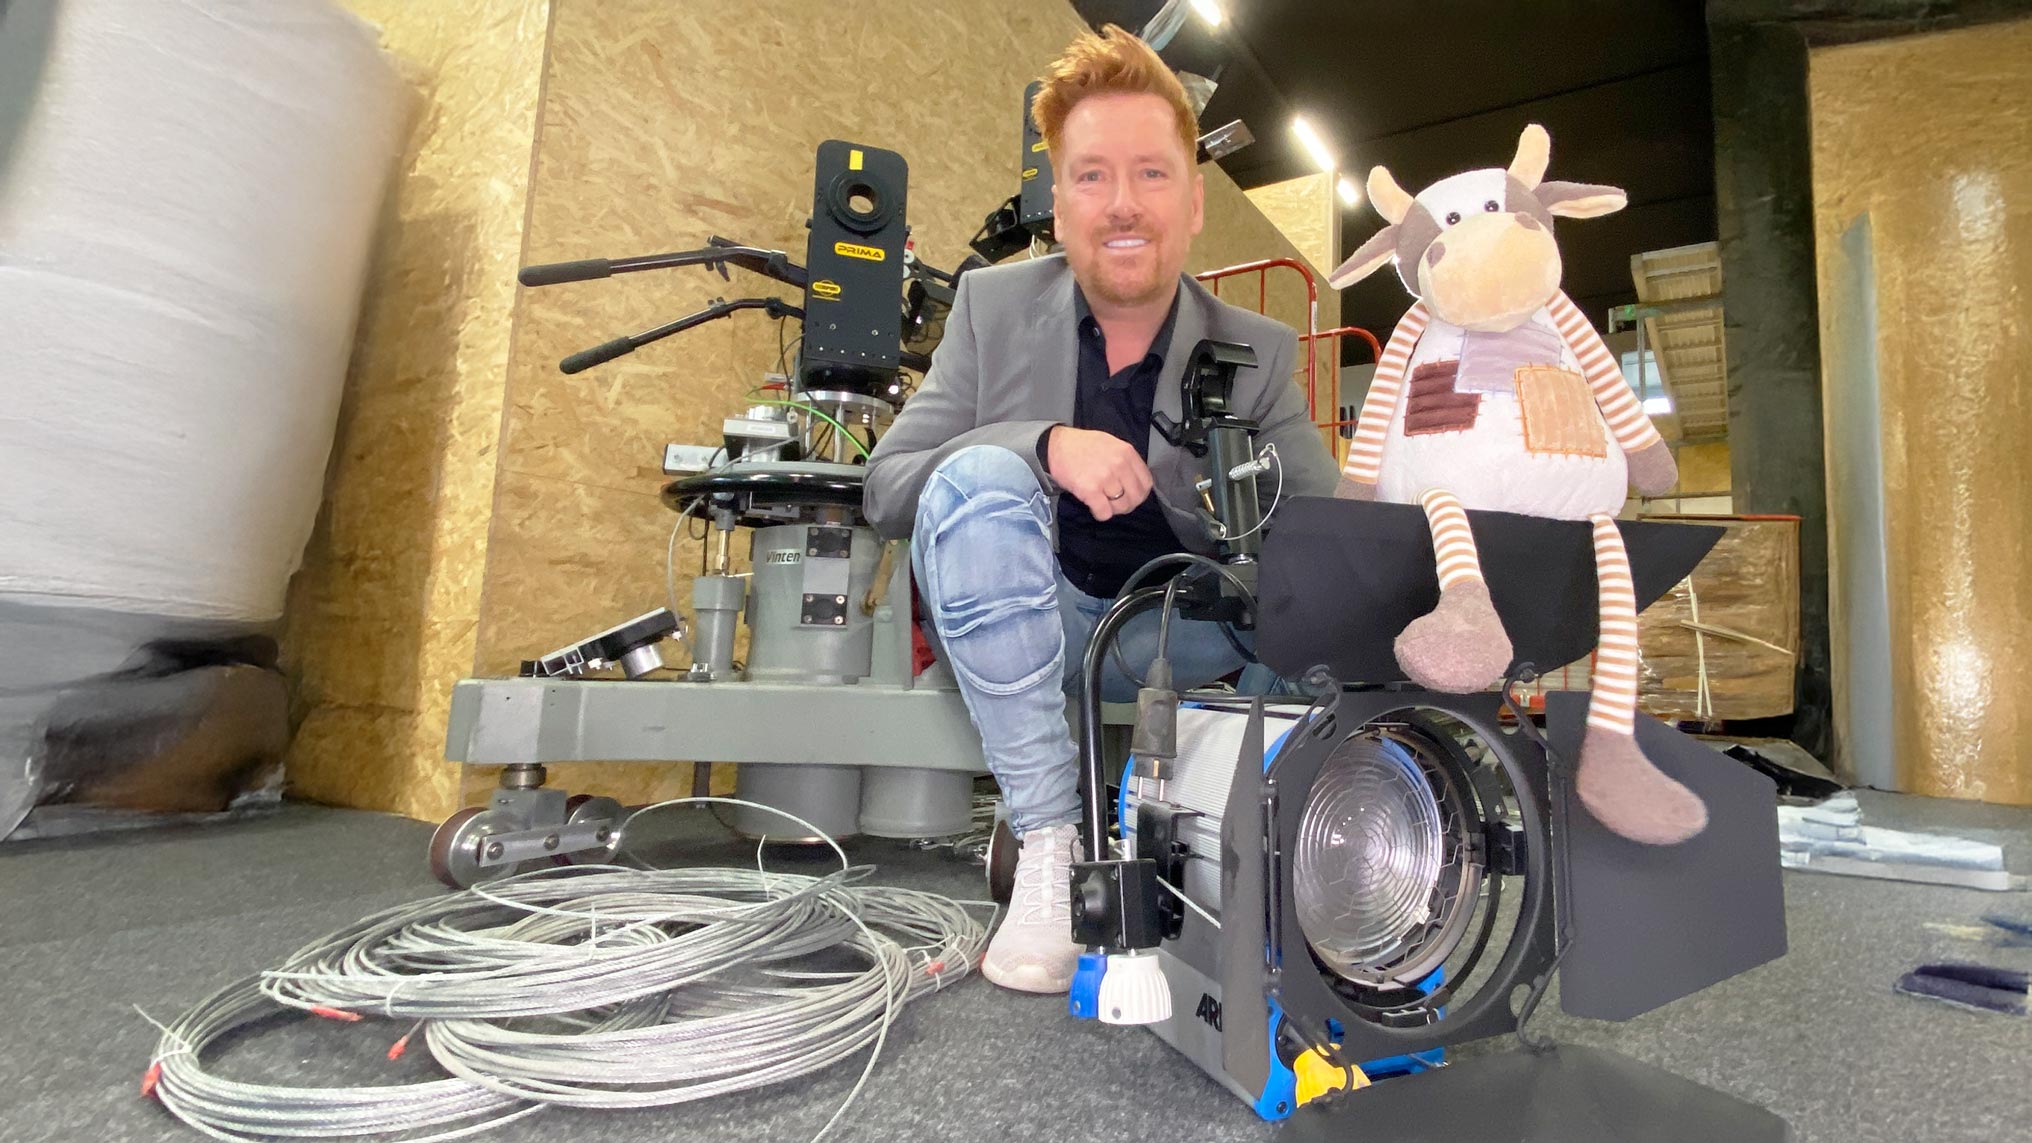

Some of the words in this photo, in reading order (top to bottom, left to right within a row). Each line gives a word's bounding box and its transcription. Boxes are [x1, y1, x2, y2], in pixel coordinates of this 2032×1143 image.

[837, 244, 883, 259] PRIMA
[766, 551, 801, 563] Vinten
[1196, 993, 1223, 1032] AR
